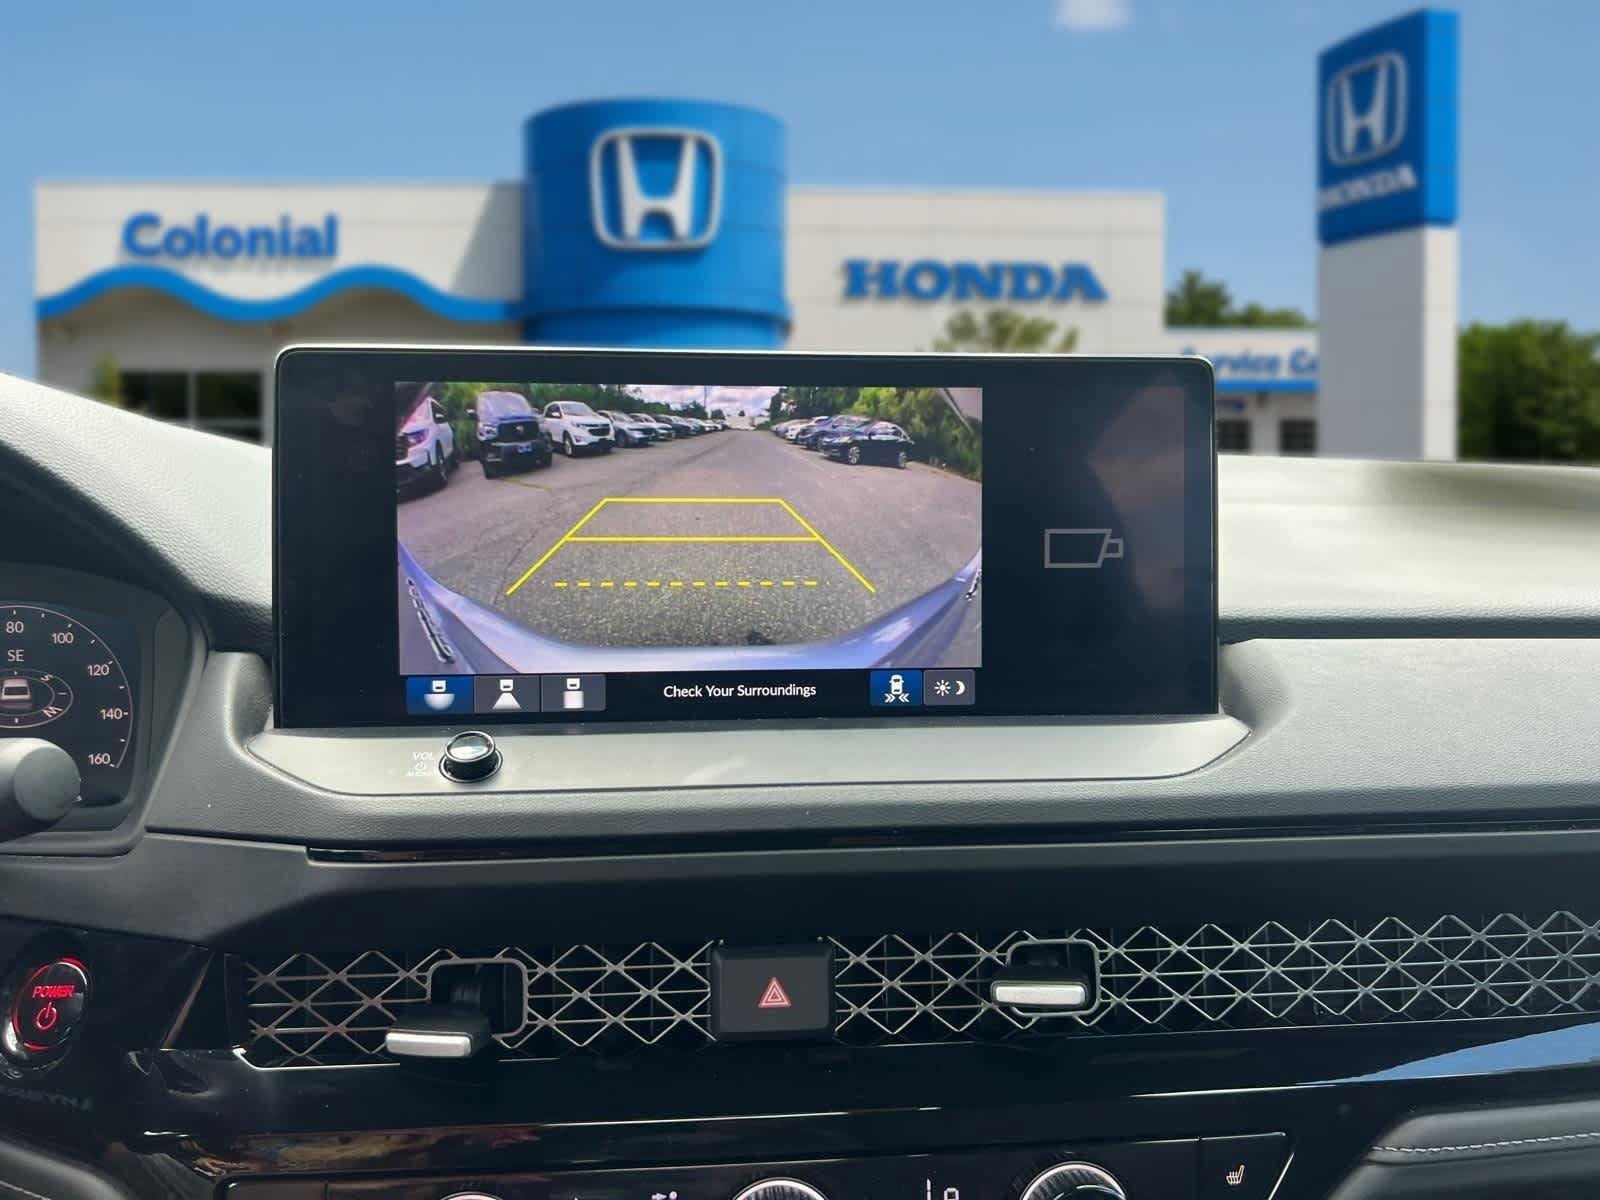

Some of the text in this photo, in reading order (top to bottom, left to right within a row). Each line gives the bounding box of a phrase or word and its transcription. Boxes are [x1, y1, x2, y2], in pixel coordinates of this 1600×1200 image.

[1318, 164, 1416, 211] HONDA
[122, 212, 338, 258] Colonial
[842, 257, 1109, 302] HONDA
[6, 621, 24, 634] 80
[52, 632, 74, 644] 100
[7, 649, 25, 662] SE
[87, 664, 110, 676] 120
[663, 684, 817, 698] Check Your Surroundings
[101, 708, 123, 720] 140
[88, 752, 111, 765] 160
[32, 984, 75, 999] POWER
